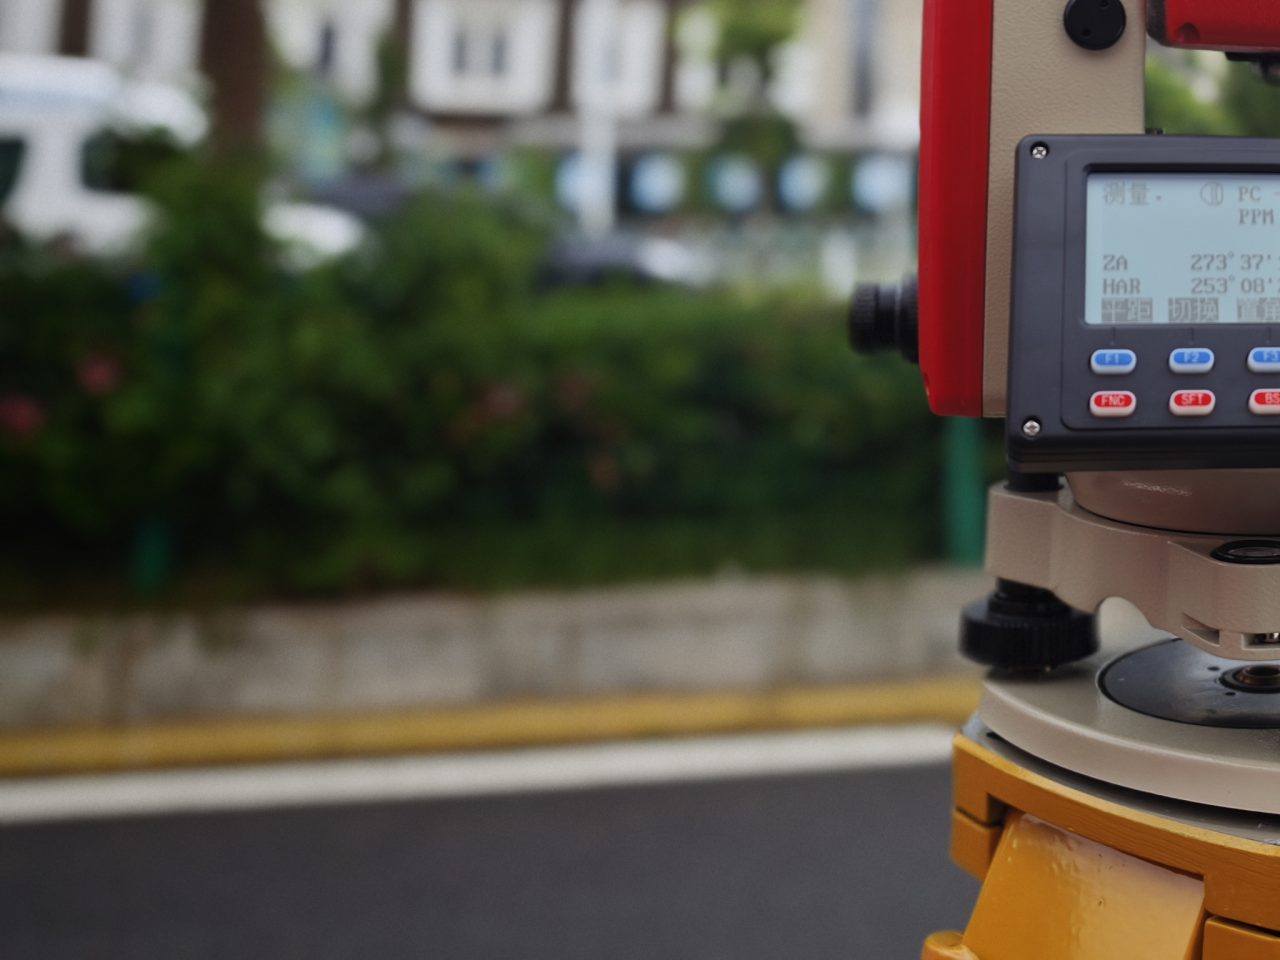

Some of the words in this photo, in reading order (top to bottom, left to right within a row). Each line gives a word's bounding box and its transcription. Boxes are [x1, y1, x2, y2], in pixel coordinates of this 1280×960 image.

[1238, 186, 1262, 202] PC
[1239, 209, 1275, 225] PPM
[1103, 254, 1128, 271] ZA
[1103, 278, 1141, 295] HAR
[1105, 352, 1119, 364] F1
[1184, 352, 1199, 363] F2
[1263, 350, 1279, 361] F3
[1101, 394, 1125, 407] FNC
[1181, 393, 1205, 405] SFT
[1265, 392, 1280, 404] BS
